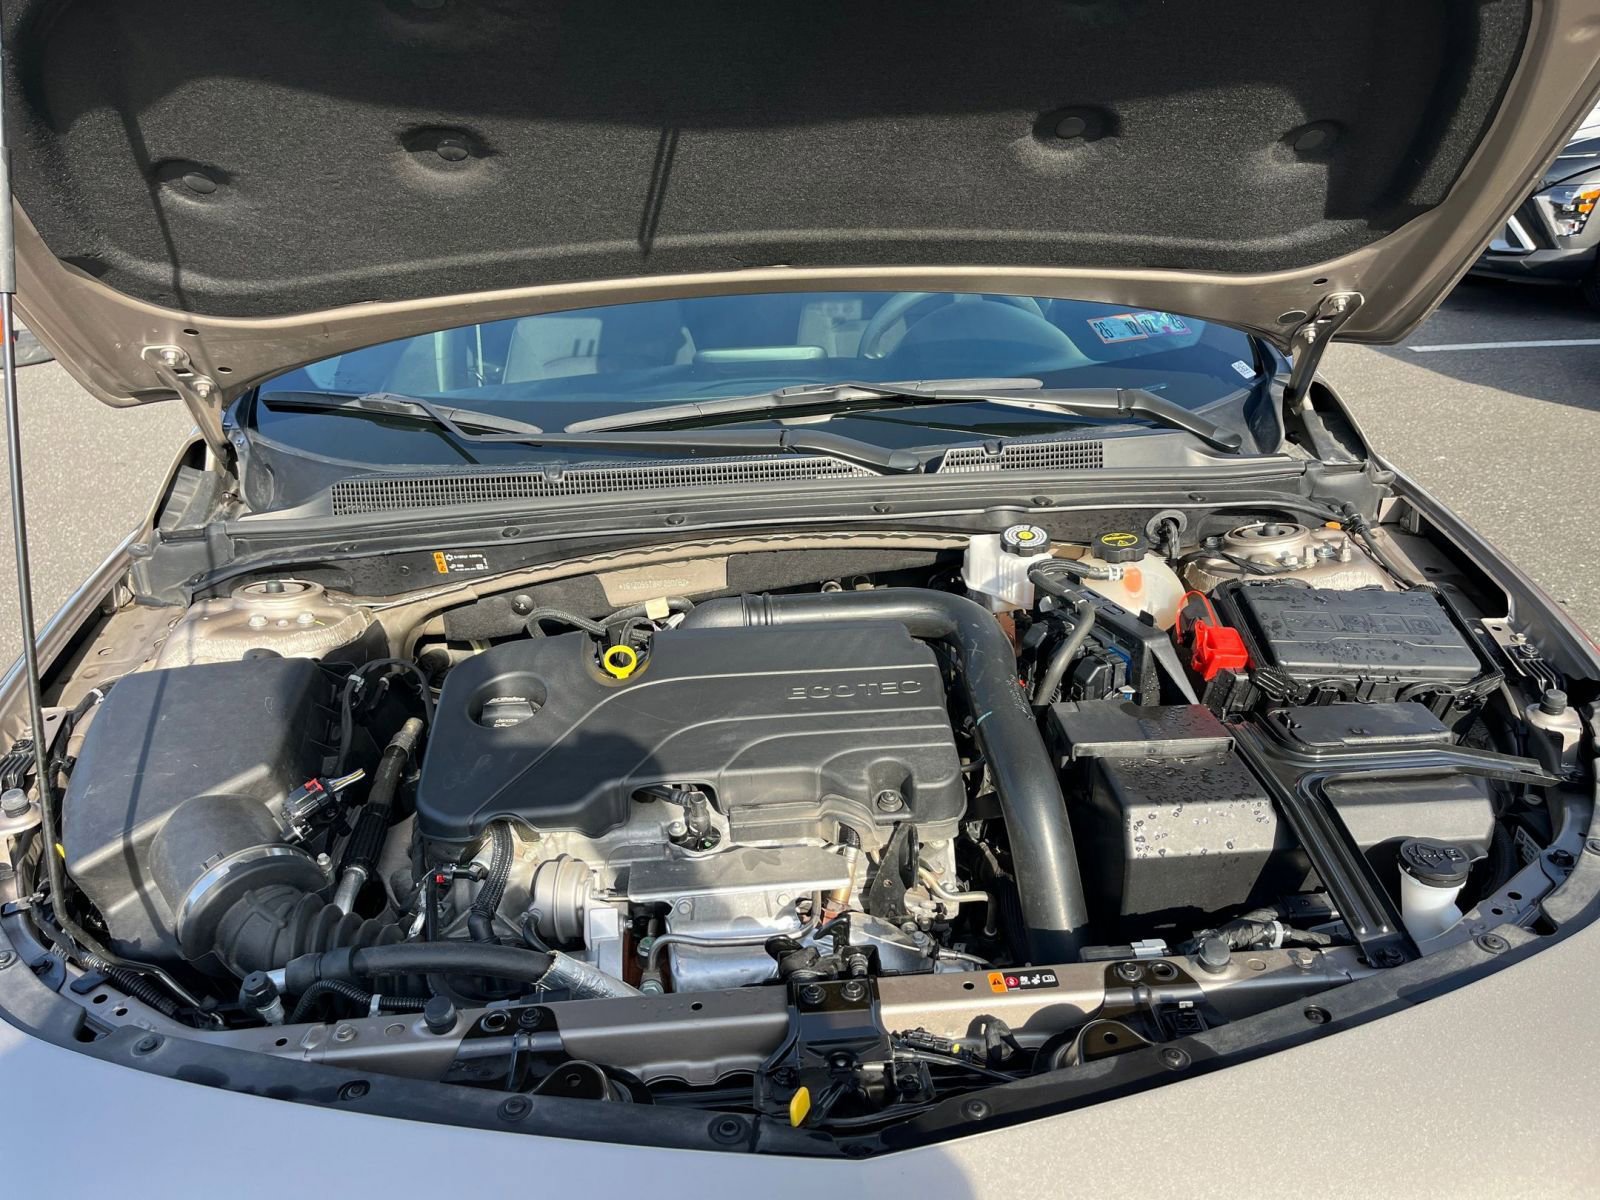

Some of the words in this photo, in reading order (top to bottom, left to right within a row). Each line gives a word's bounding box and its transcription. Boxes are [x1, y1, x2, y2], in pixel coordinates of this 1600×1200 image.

[1094, 321, 1114, 339] 26
[1125, 321, 1143, 335] 12
[1141, 319, 1159, 333] 12
[788, 680, 922, 699] ECOTEC
